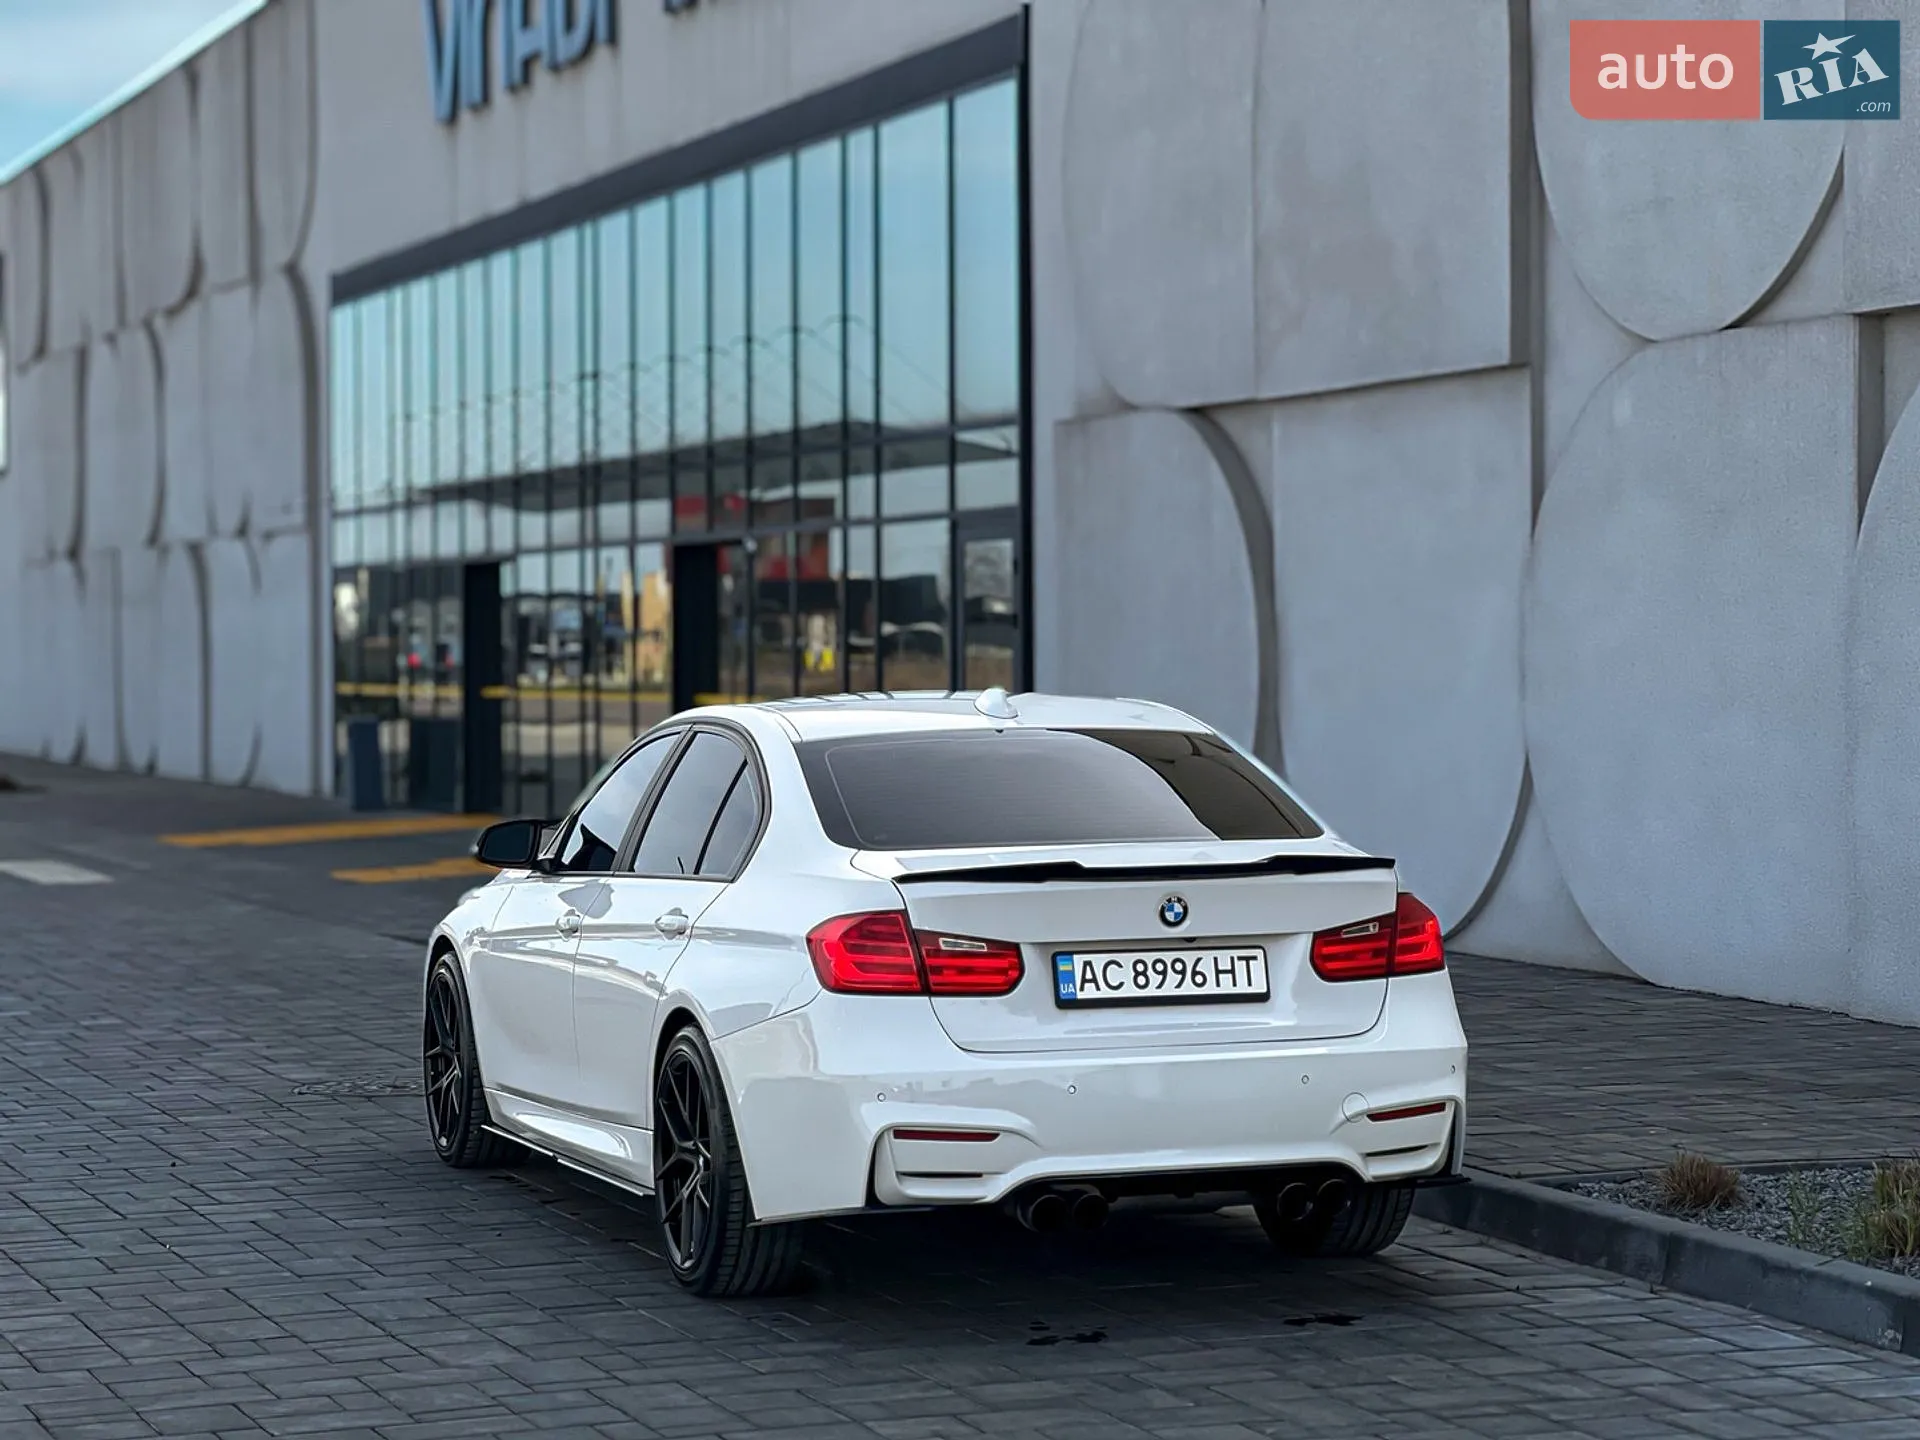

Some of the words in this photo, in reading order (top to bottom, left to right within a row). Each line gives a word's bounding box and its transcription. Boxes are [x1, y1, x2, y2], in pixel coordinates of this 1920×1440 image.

[1079, 960, 1124, 992] AC
[1132, 957, 1208, 989] 8996
[1213, 955, 1258, 988] HT
[1060, 983, 1075, 995] UA
